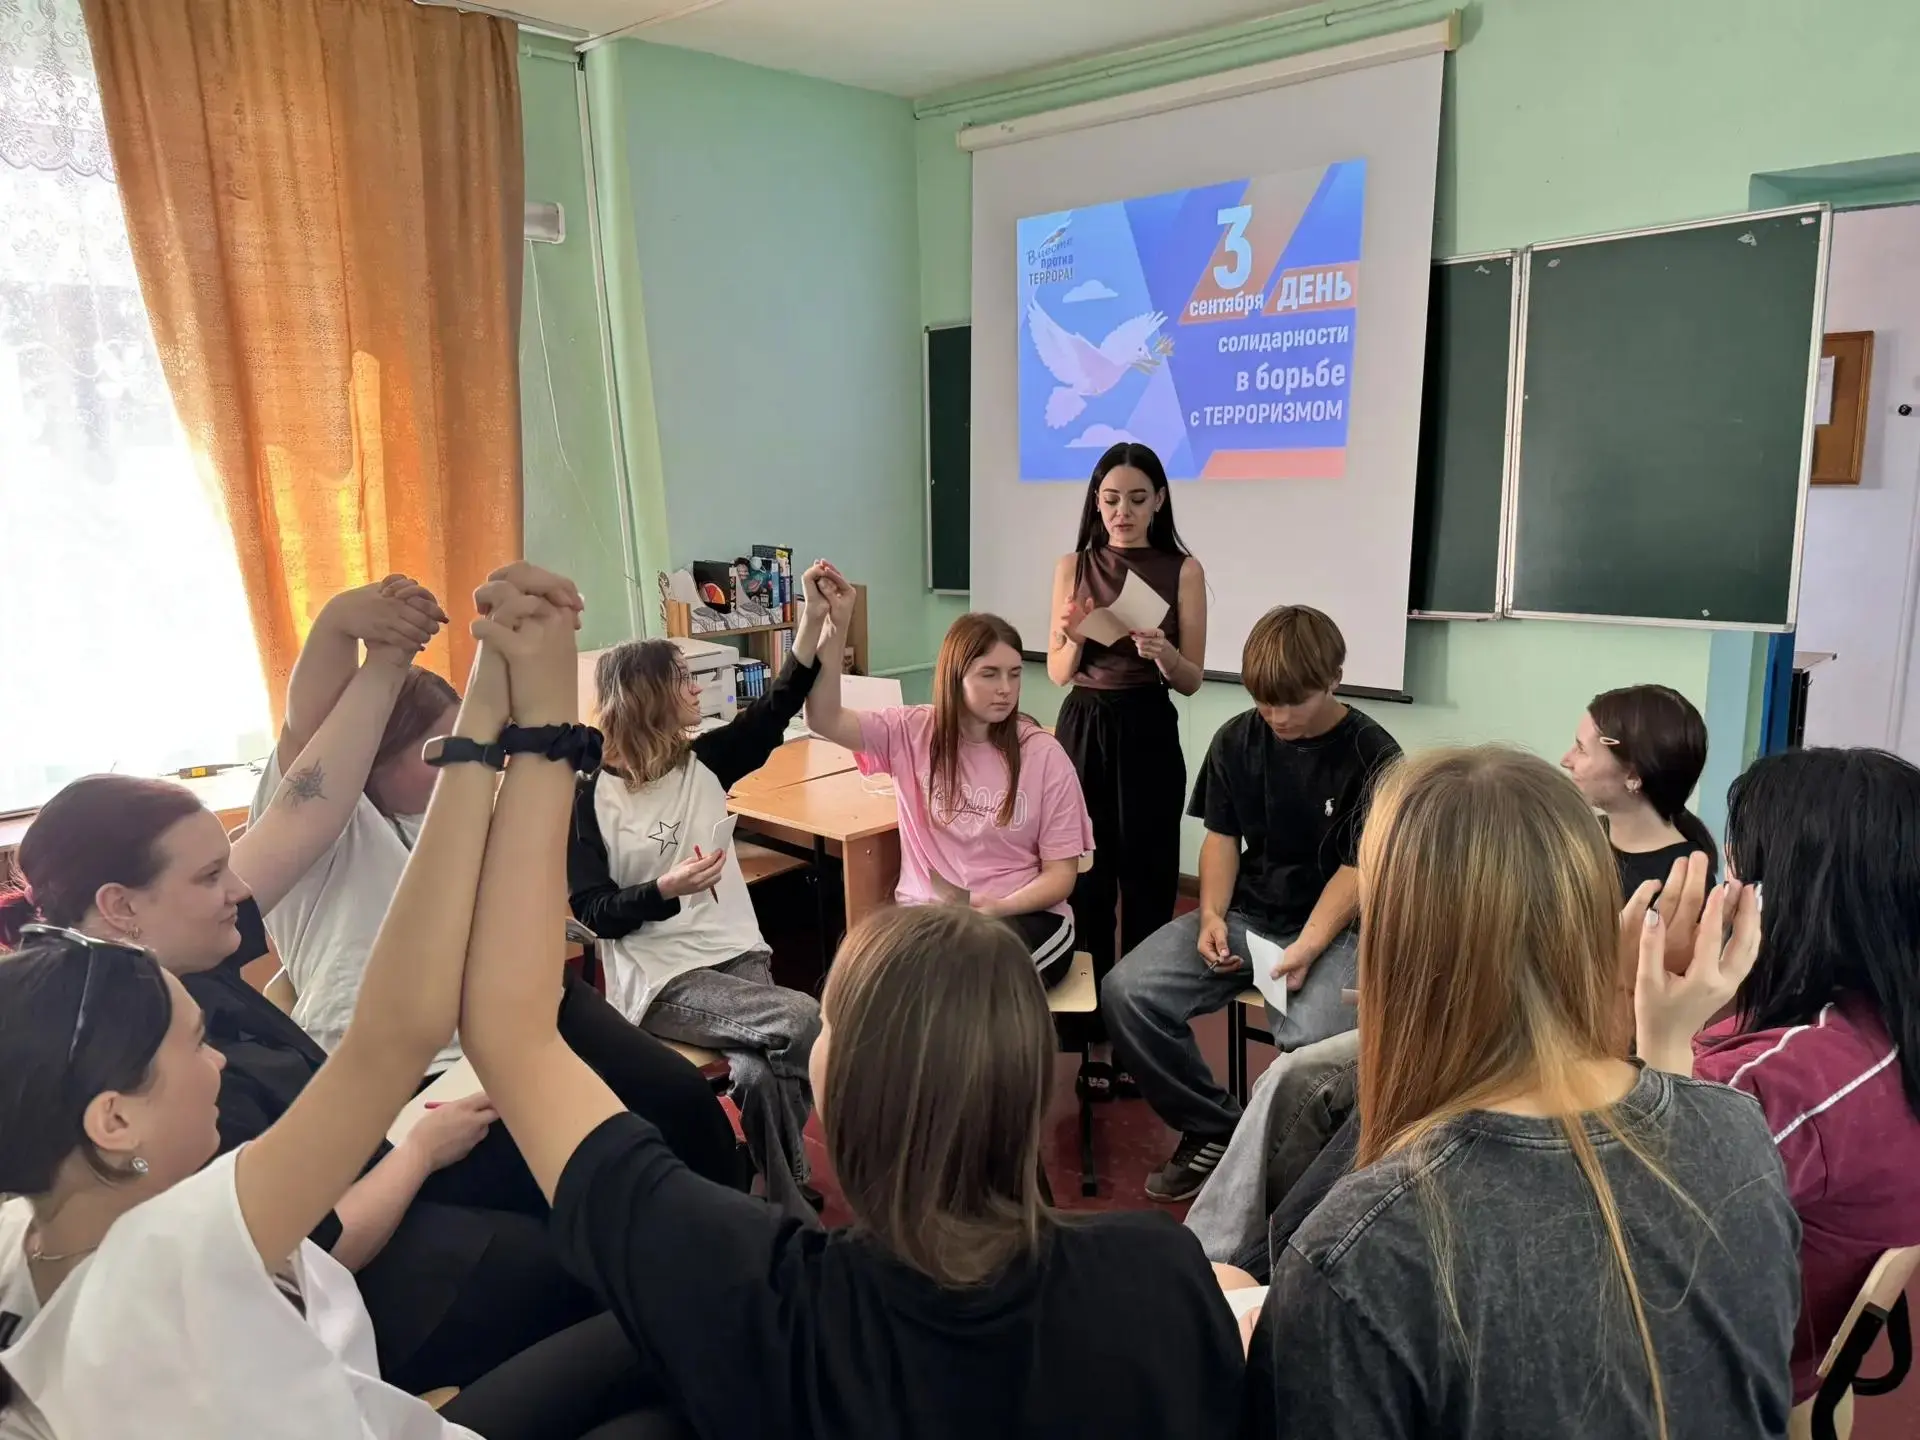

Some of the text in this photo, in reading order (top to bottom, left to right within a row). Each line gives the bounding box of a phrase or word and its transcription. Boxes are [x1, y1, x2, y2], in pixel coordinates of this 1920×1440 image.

[1213, 204, 1252, 290] 3
[1040, 254, 1074, 270] против
[1028, 268, 1074, 287] ТЕРРОРА!
[1189, 290, 1265, 317] сентября
[1276, 271, 1352, 312] ДЕНЬ
[1218, 325, 1349, 353] солидарности
[1235, 357, 1346, 396] в борьбе
[1190, 400, 1343, 427] с ТЕРРОРИЗМОМ
